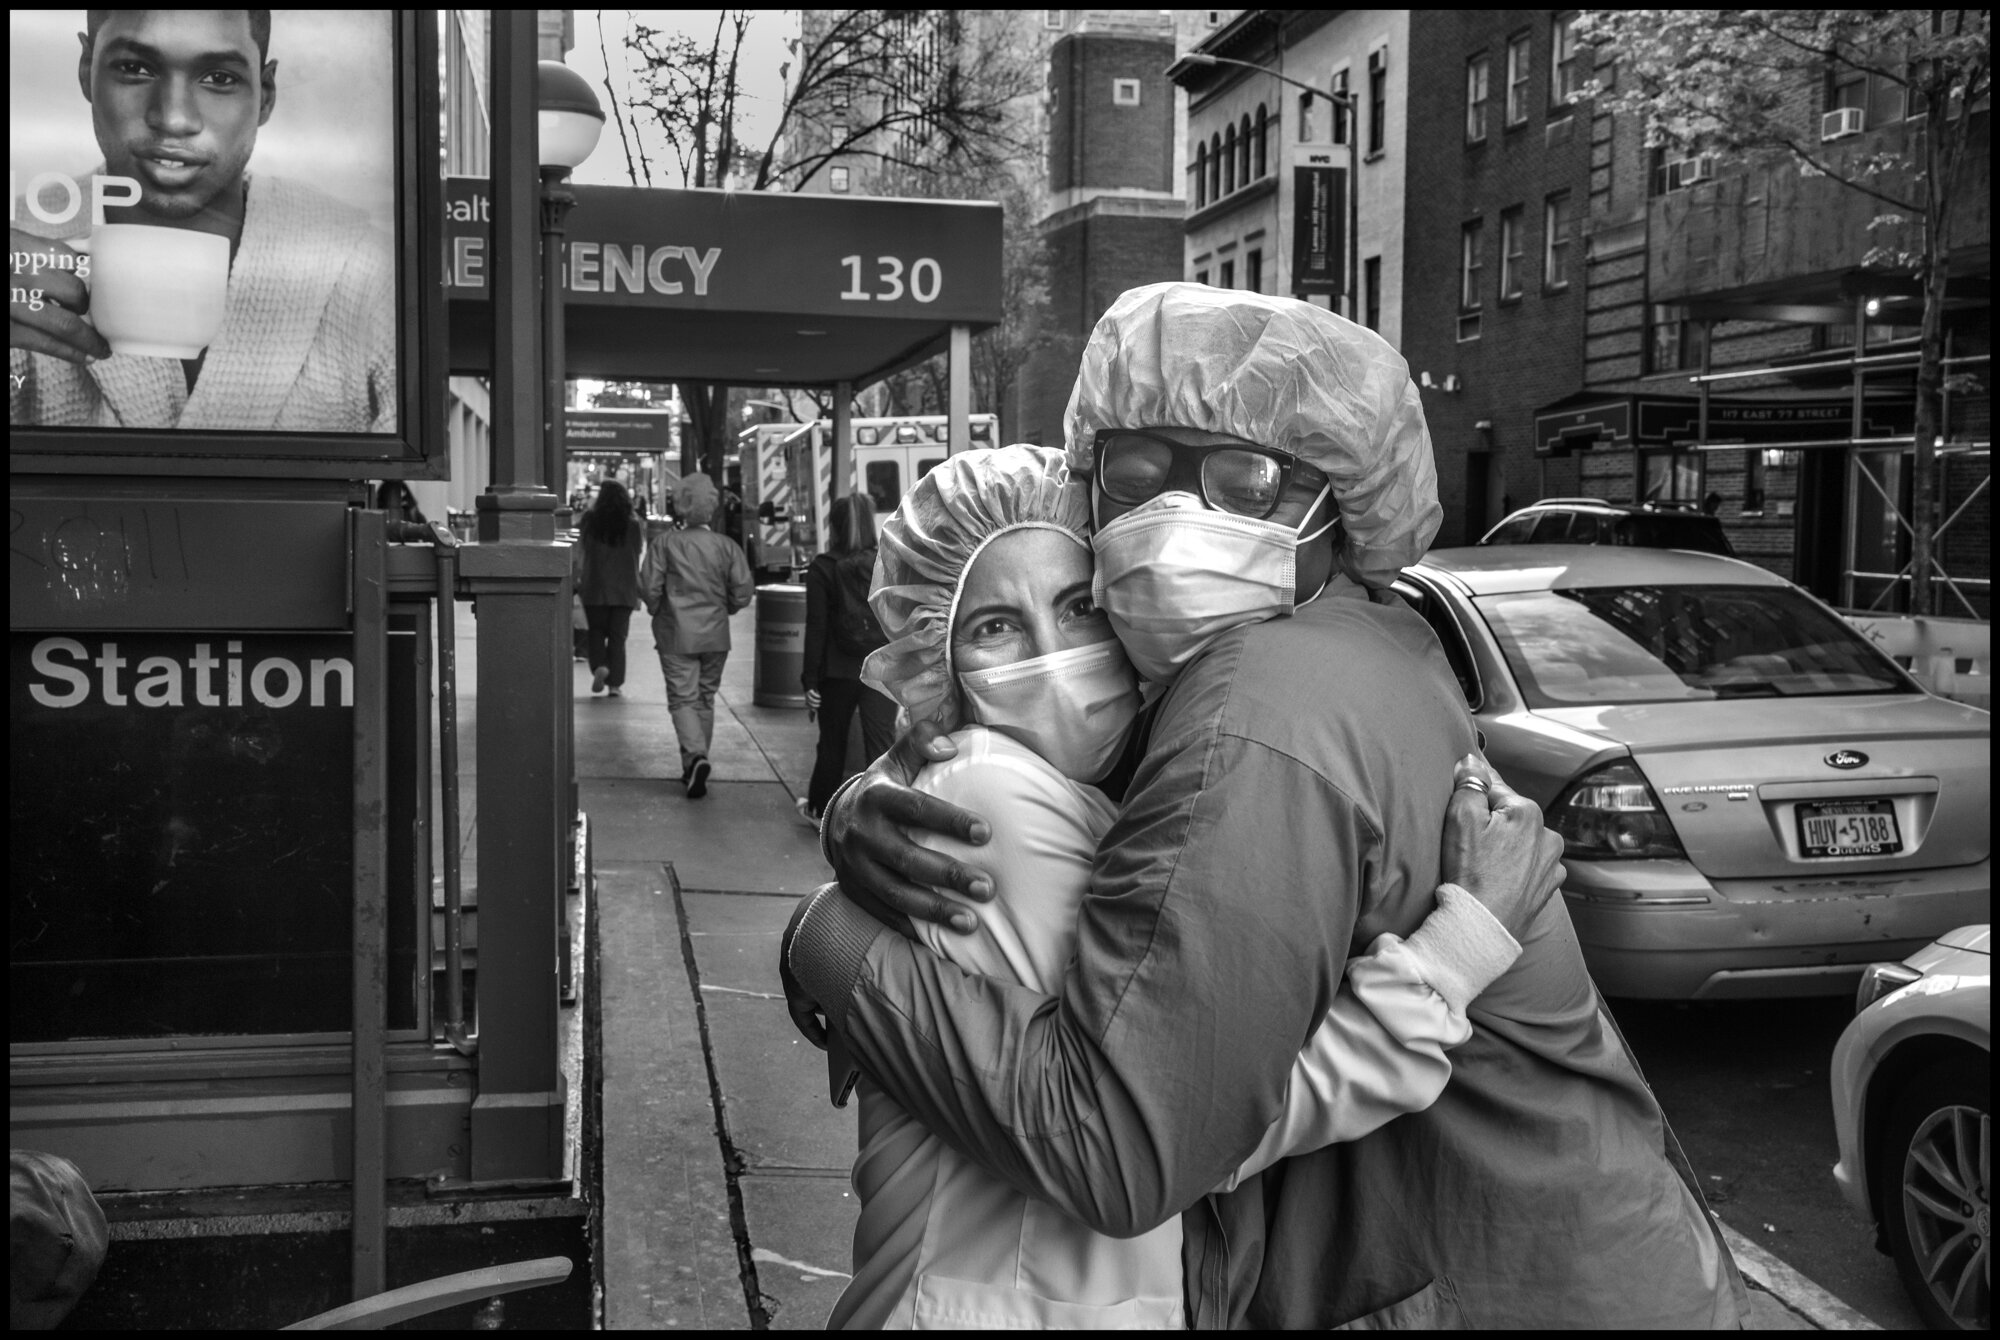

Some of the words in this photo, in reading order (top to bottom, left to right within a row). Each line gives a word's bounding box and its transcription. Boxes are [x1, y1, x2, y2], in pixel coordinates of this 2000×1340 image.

[10, 171, 142, 225] OP
[839, 254, 943, 303] 130
[1742, 409, 1773, 420] EAST
[1778, 409, 1794, 418] 77
[1797, 408, 1842, 418] STREET
[566, 429, 617, 438] Ambulance
[29, 636, 355, 709] Station
[1663, 786, 1692, 795] FIVE
[1694, 783, 1755, 793] HUNDRED
[1808, 818, 1838, 846] HUV
[1848, 816, 1890, 844] 5188
